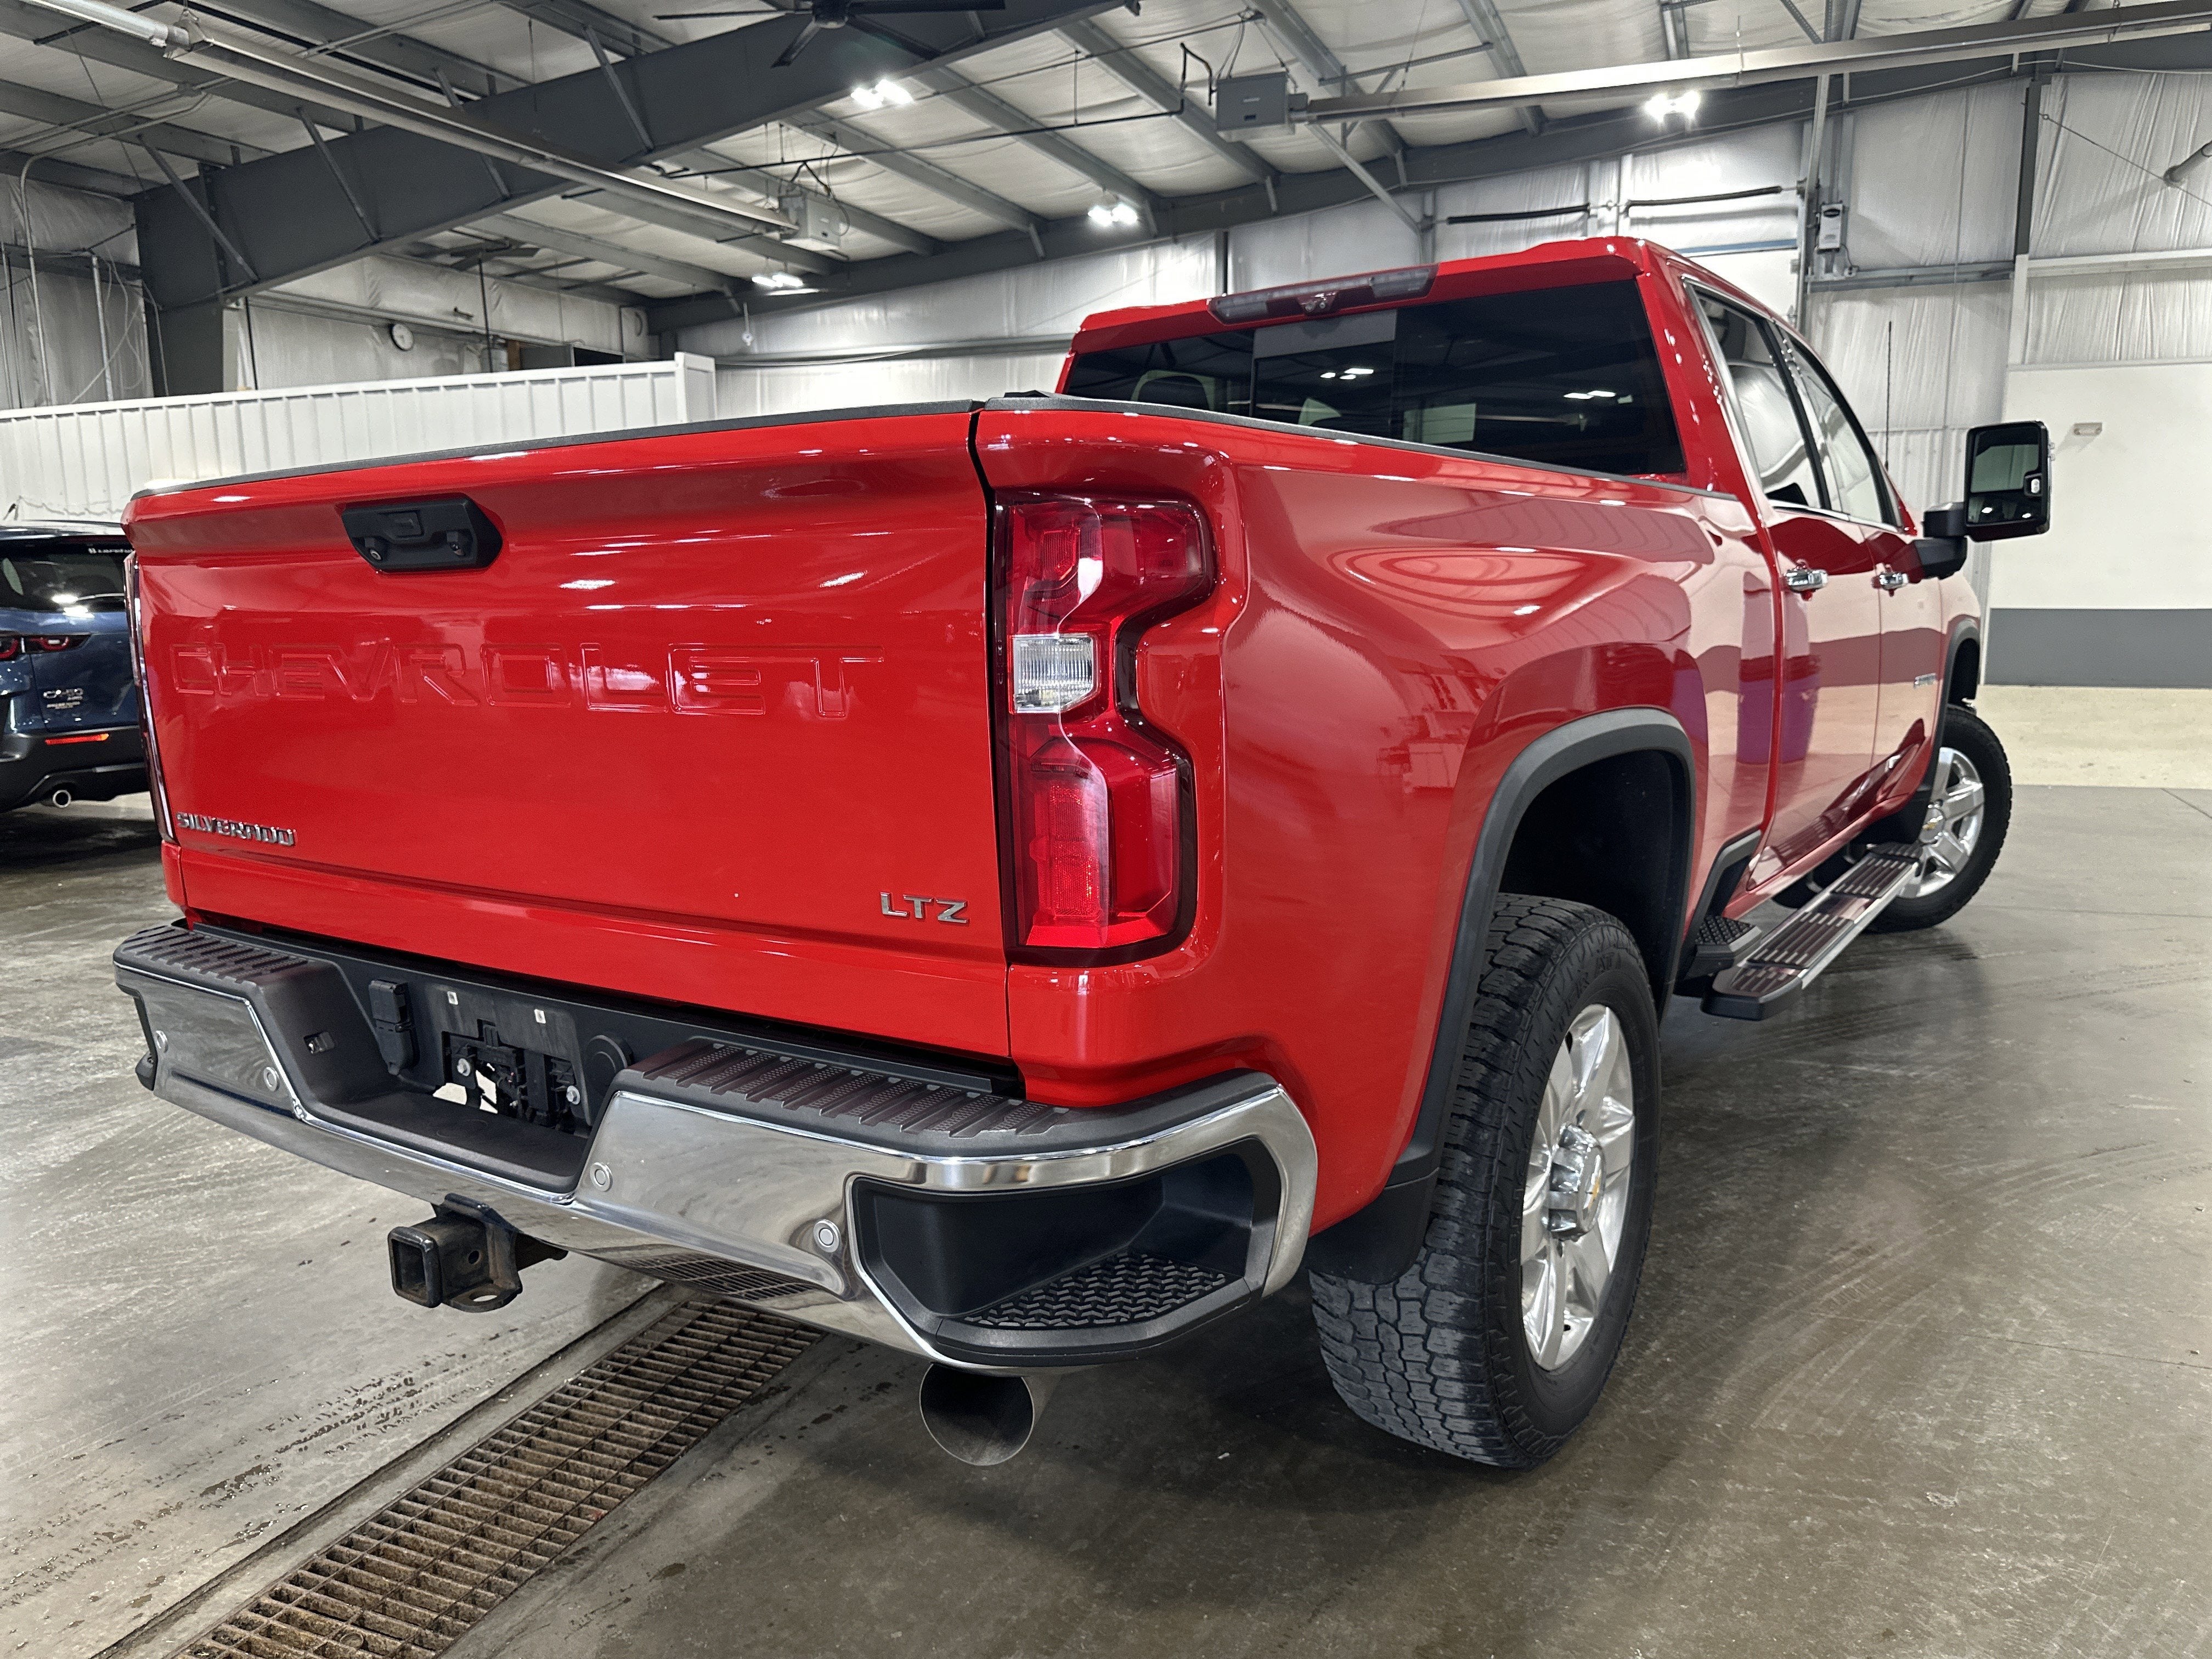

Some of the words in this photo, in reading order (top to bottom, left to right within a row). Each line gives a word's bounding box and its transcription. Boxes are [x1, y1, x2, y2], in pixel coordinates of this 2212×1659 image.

[170, 642, 885, 718] CHEVROLET
[176, 811, 297, 847] SILVERADO
[880, 891, 969, 926] LTZ
